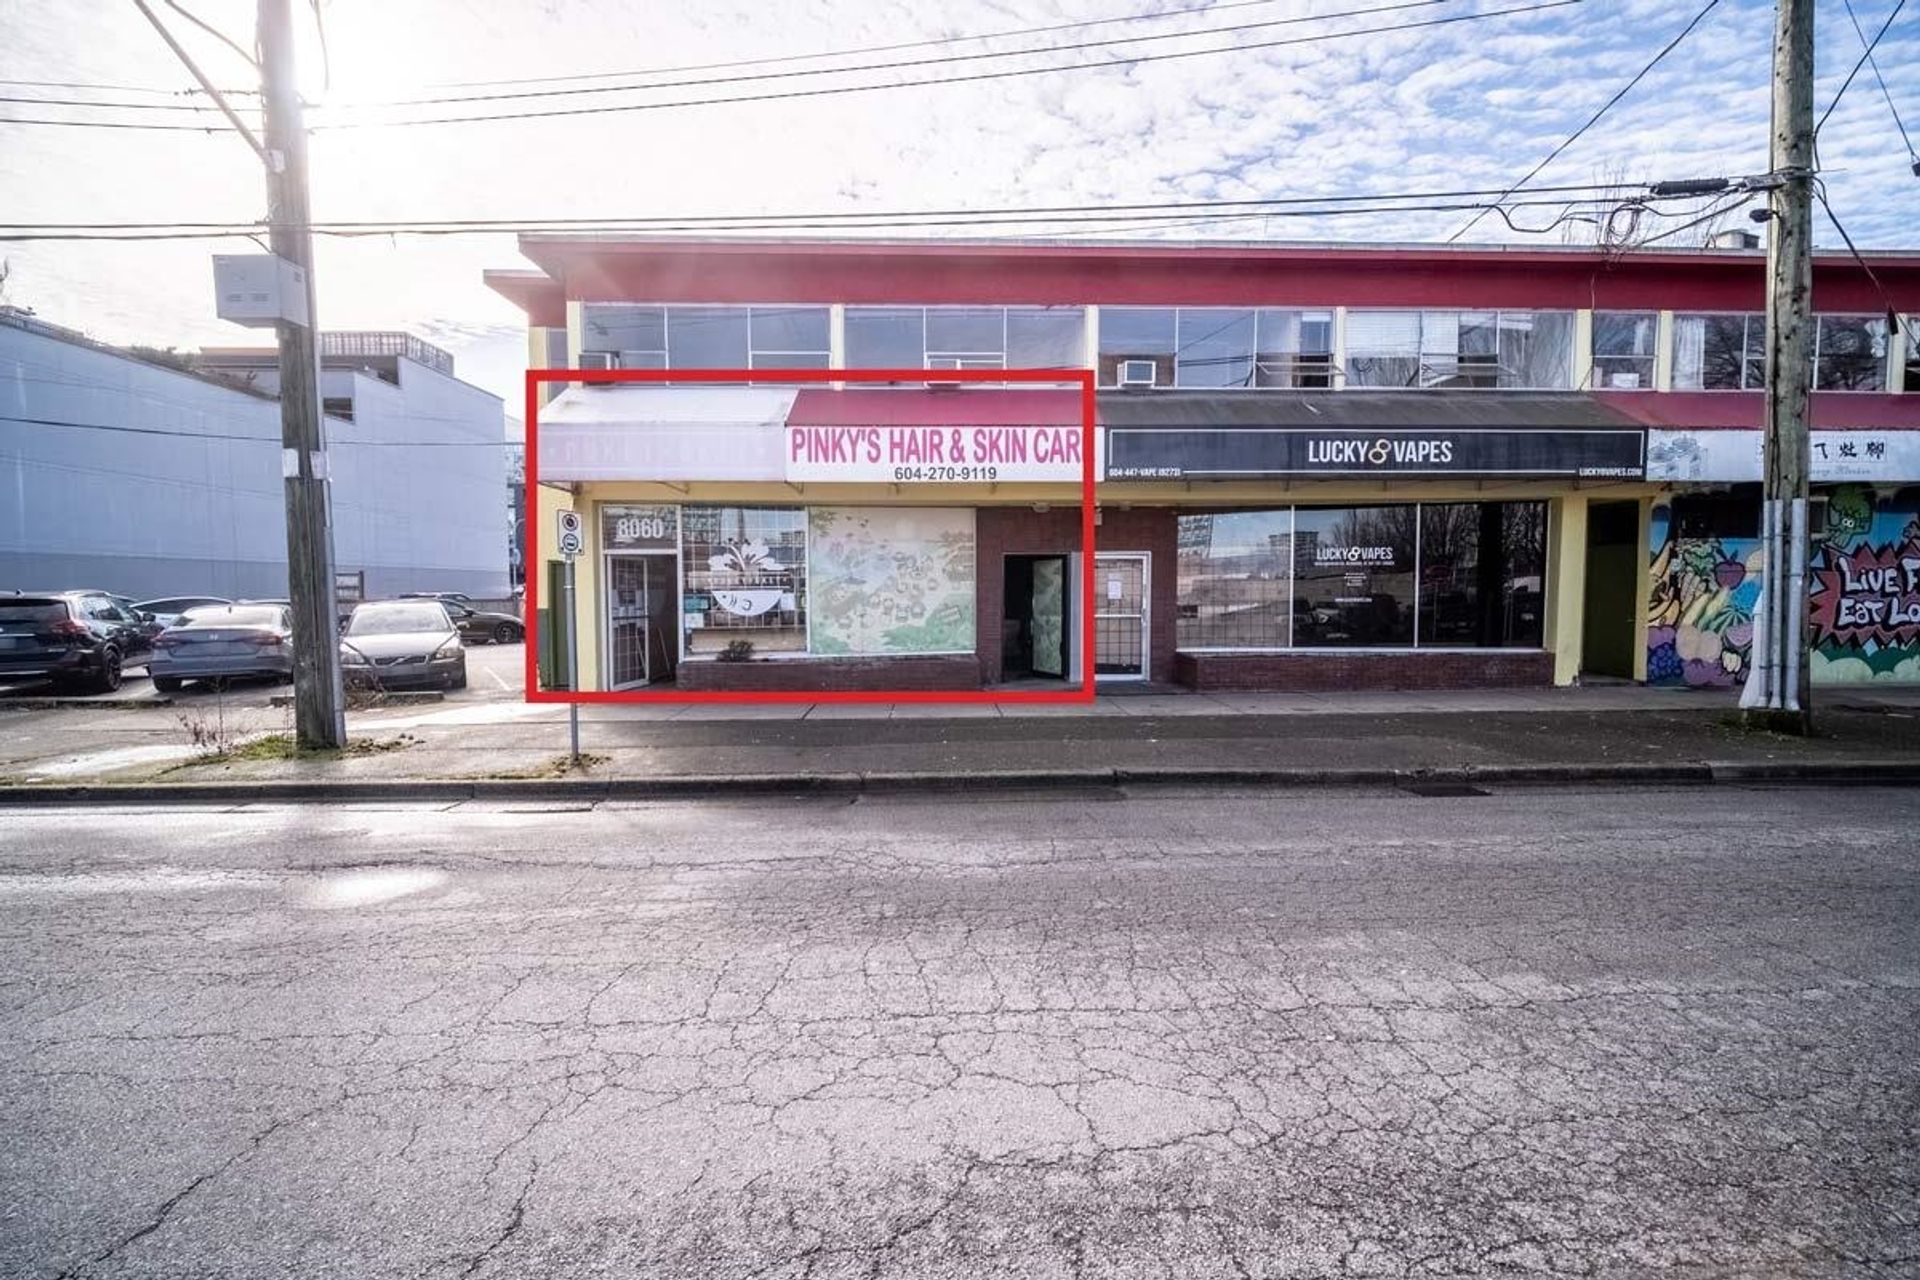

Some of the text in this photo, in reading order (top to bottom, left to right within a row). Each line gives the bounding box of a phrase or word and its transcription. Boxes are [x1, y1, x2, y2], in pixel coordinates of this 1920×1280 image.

[791, 428, 882, 464] PINKY'S
[889, 428, 944, 463] HAIR
[949, 428, 966, 463] &
[973, 428, 1027, 463] SKIN
[1033, 428, 1082, 464] CAR
[1308, 440, 1369, 462] LUCKY
[1393, 440, 1453, 462] VAPES
[894, 467, 997, 480] 604-270-9119
[617, 519, 664, 538] 8060
[1315, 548, 1348, 560] LUCKY
[1361, 547, 1393, 560] VAPES
